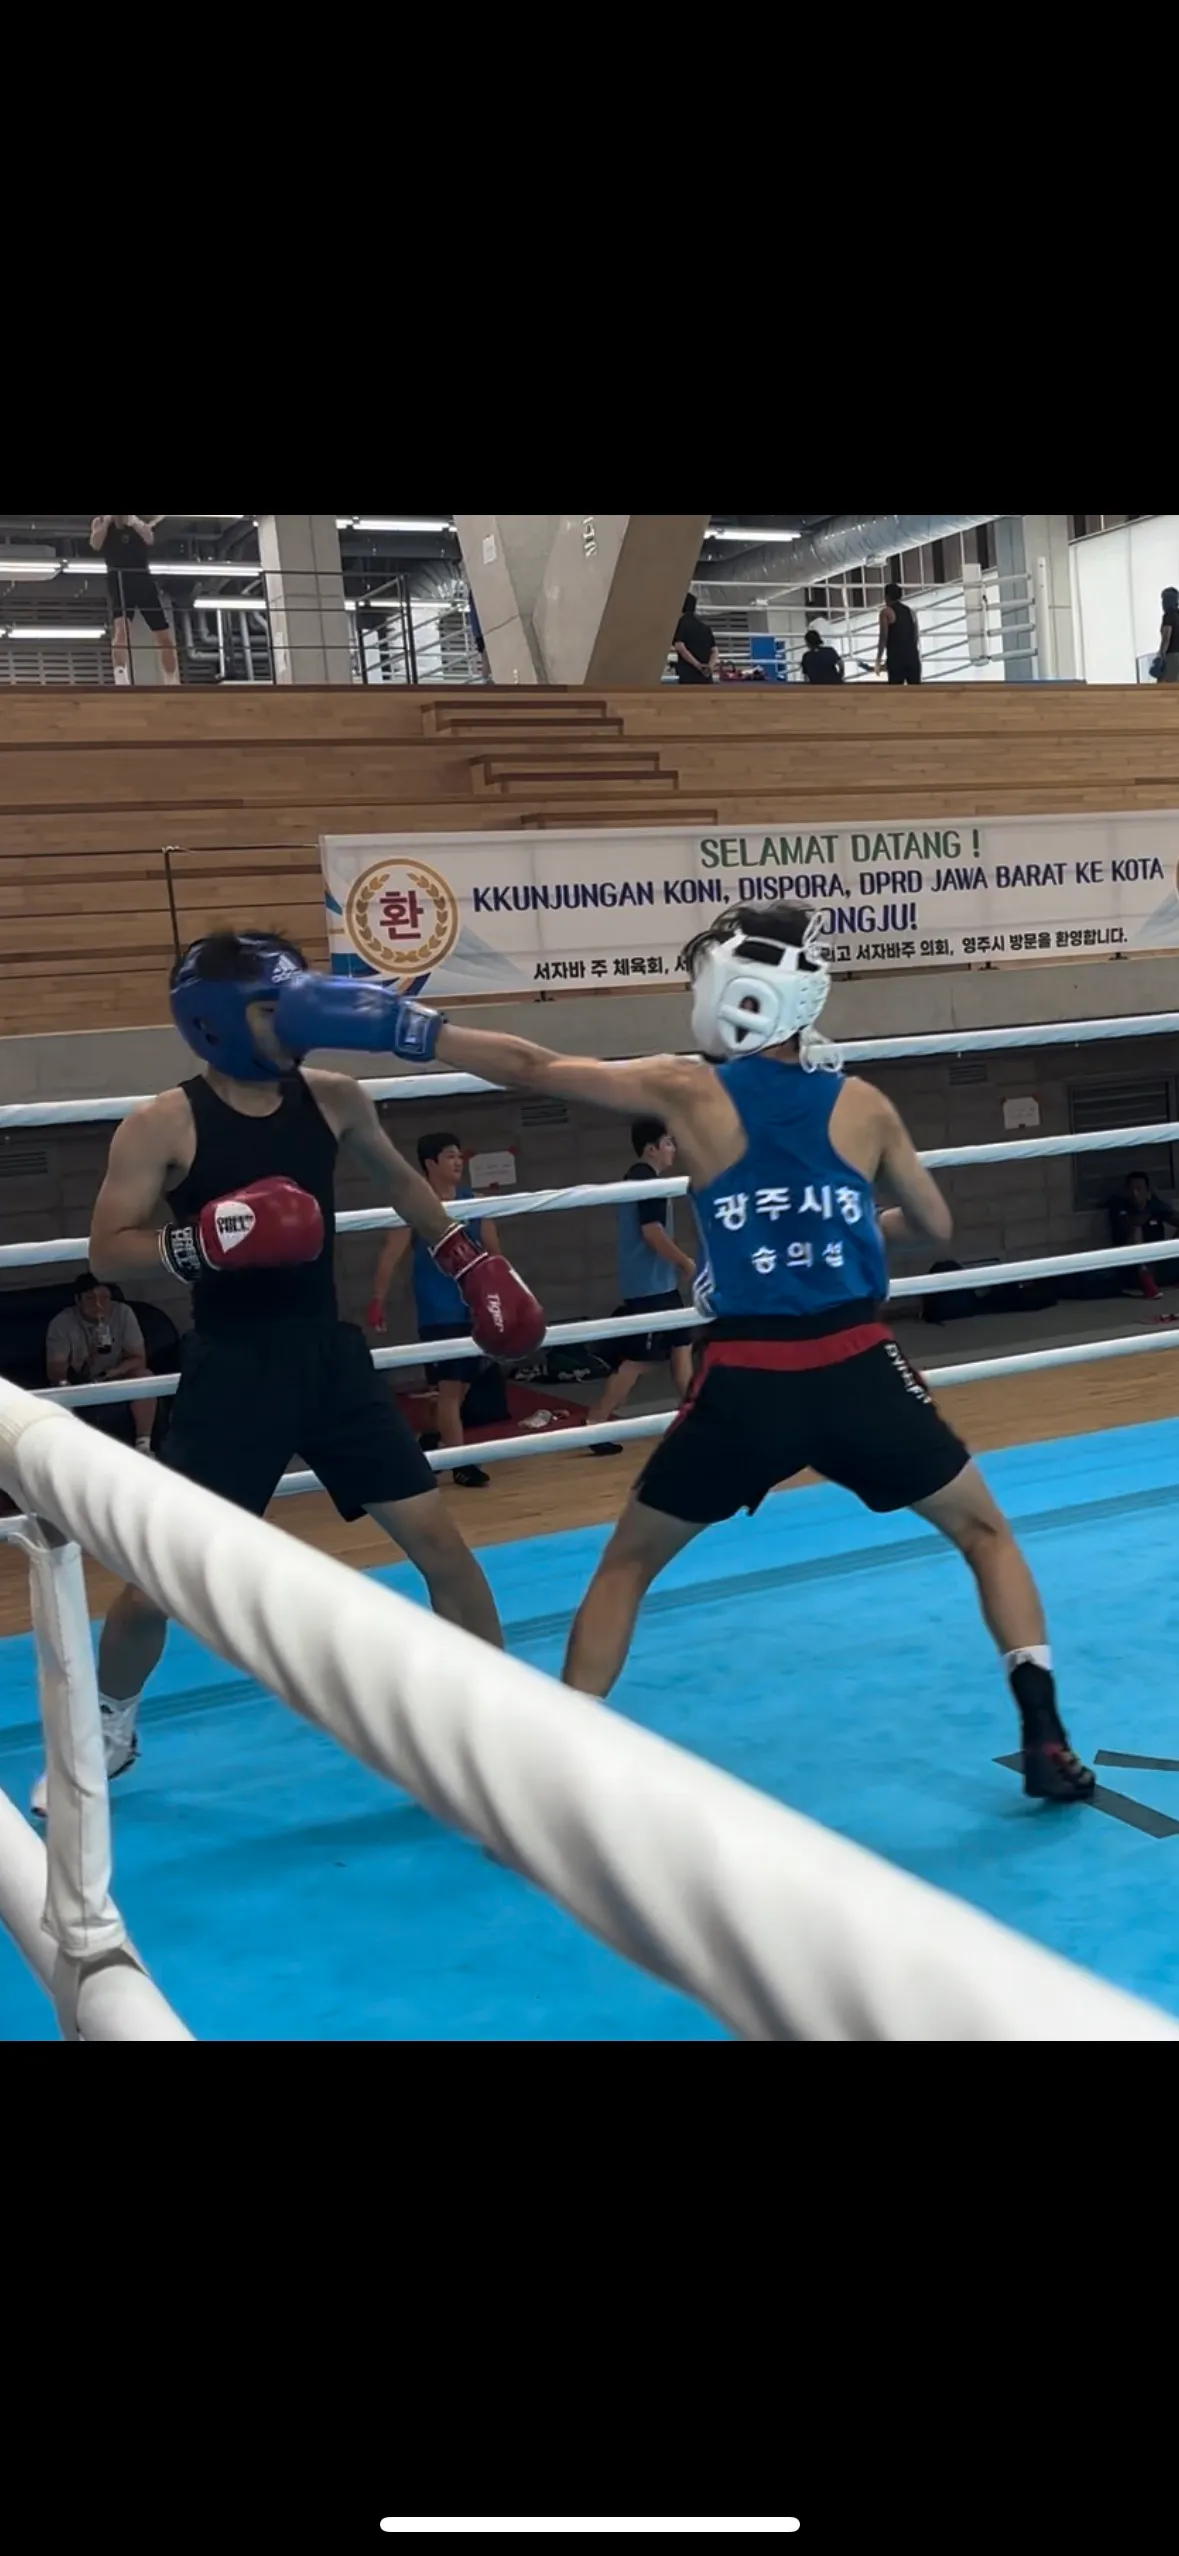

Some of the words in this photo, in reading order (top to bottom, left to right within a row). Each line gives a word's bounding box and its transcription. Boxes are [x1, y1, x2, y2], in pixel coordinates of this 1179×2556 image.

[701, 835, 839, 868] SELAMAT
[851, 830, 961, 862] DATANG
[972, 829, 980, 858] !
[473, 881, 654, 912] KKUNJUNGAN
[663, 878, 730, 904] KONI,
[738, 873, 851, 901] DISPORA,
[860, 870, 922, 895] DPRD
[931, 867, 988, 892] JAWA
[996, 863, 1067, 888] BARAT
[1075, 861, 1103, 884] KE
[1111, 858, 1164, 882] KOTA
[379, 890, 425, 941] 환
[810, 903, 917, 936] ONGJU!
[533, 960, 586, 981] 서자바
[591, 959, 608, 978] 주
[613, 956, 669, 976] 체육회,
[820, 945, 851, 962] 리고
[856, 941, 916, 960] 서자바주
[920, 938, 954, 957] 의회,
[962, 935, 1005, 953] 영주시
[1010, 932, 1052, 950] 방문을
[1055, 927, 1128, 948] 환영합니다.
